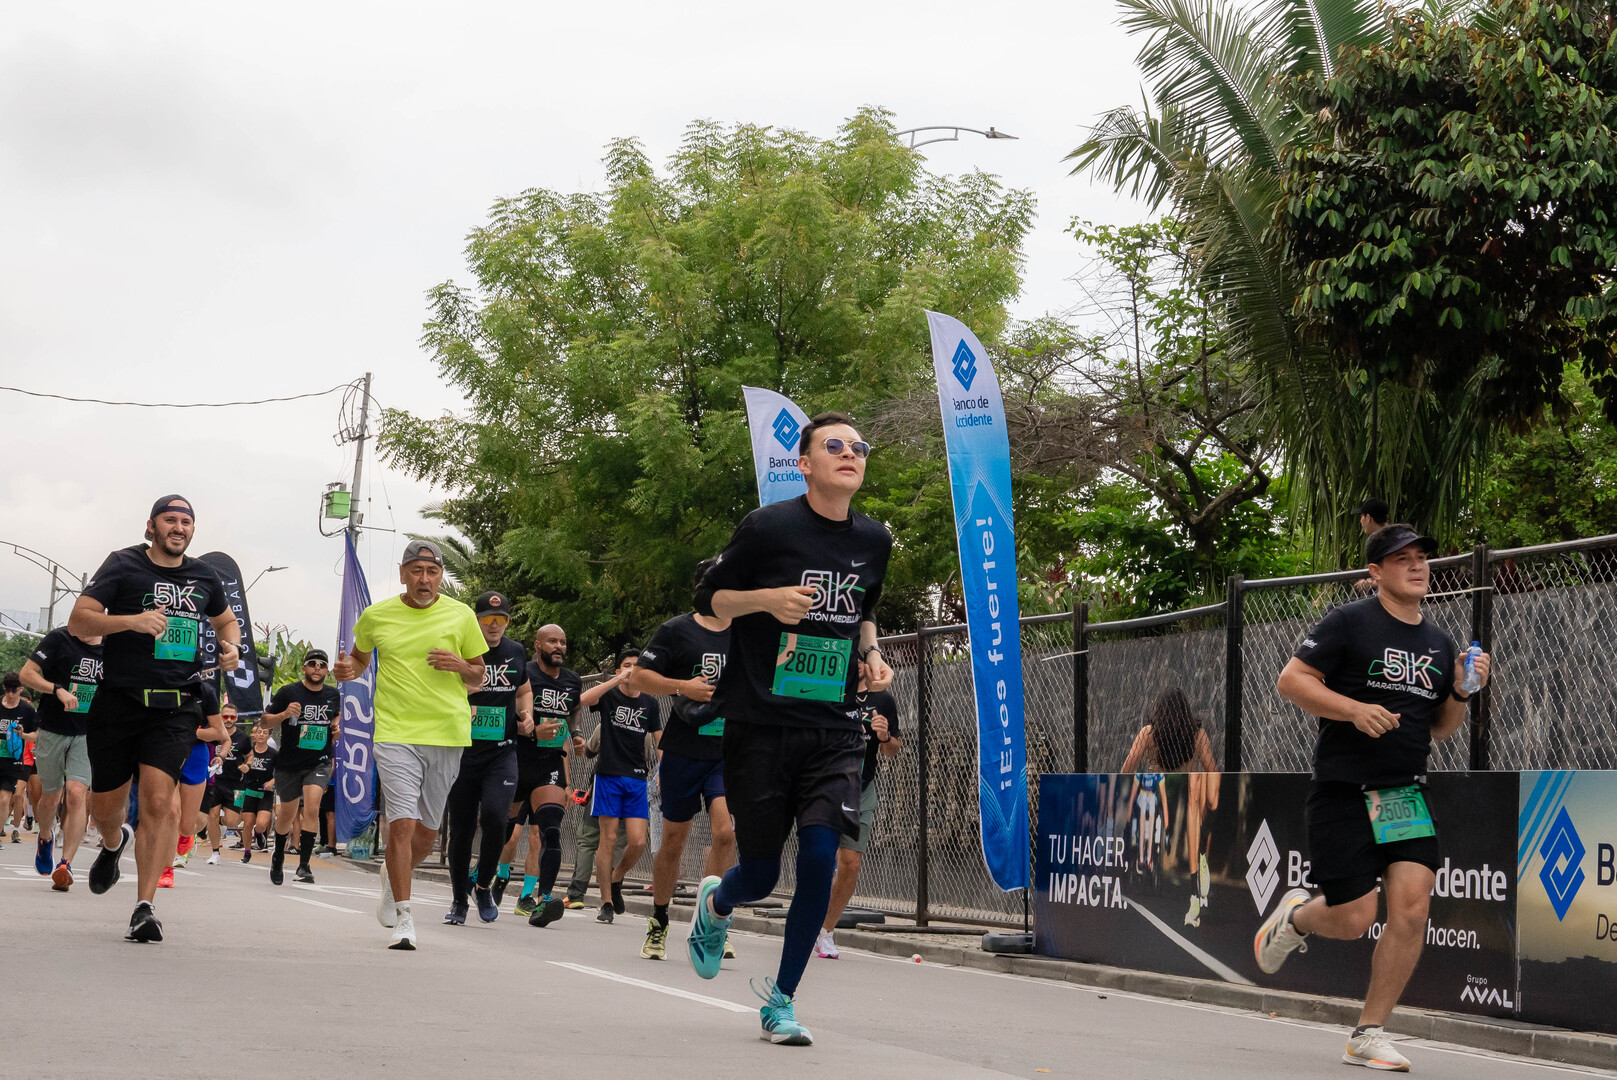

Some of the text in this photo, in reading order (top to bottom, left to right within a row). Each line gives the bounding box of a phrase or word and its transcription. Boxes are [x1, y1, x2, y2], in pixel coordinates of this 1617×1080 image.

[977, 395, 989, 408] de
[769, 457, 798, 468] Banco
[154, 583, 197, 612] 5K
[800, 570, 860, 613] 5K
[976, 516, 1004, 666] fuerte!
[805, 611, 829, 622] ATÓN
[160, 628, 193, 645] 28817
[79, 657, 104, 680] 5K
[784, 650, 838, 677] 28019
[1382, 647, 1434, 690] 5K
[541, 688, 569, 712] 5K
[303, 704, 329, 721] 5K
[471, 714, 500, 727] 28735
[615, 705, 643, 728] 5K
[302, 731, 324, 742] 28749
[1375, 800, 1418, 823] 25067
[1049, 834, 1129, 873] TU HACER,
[1048, 872, 1128, 910] IMPACTA.
[1426, 918, 1481, 950] hacen.
[1466, 974, 1488, 985] Grupo
[1460, 985, 1514, 1008] AVAL
